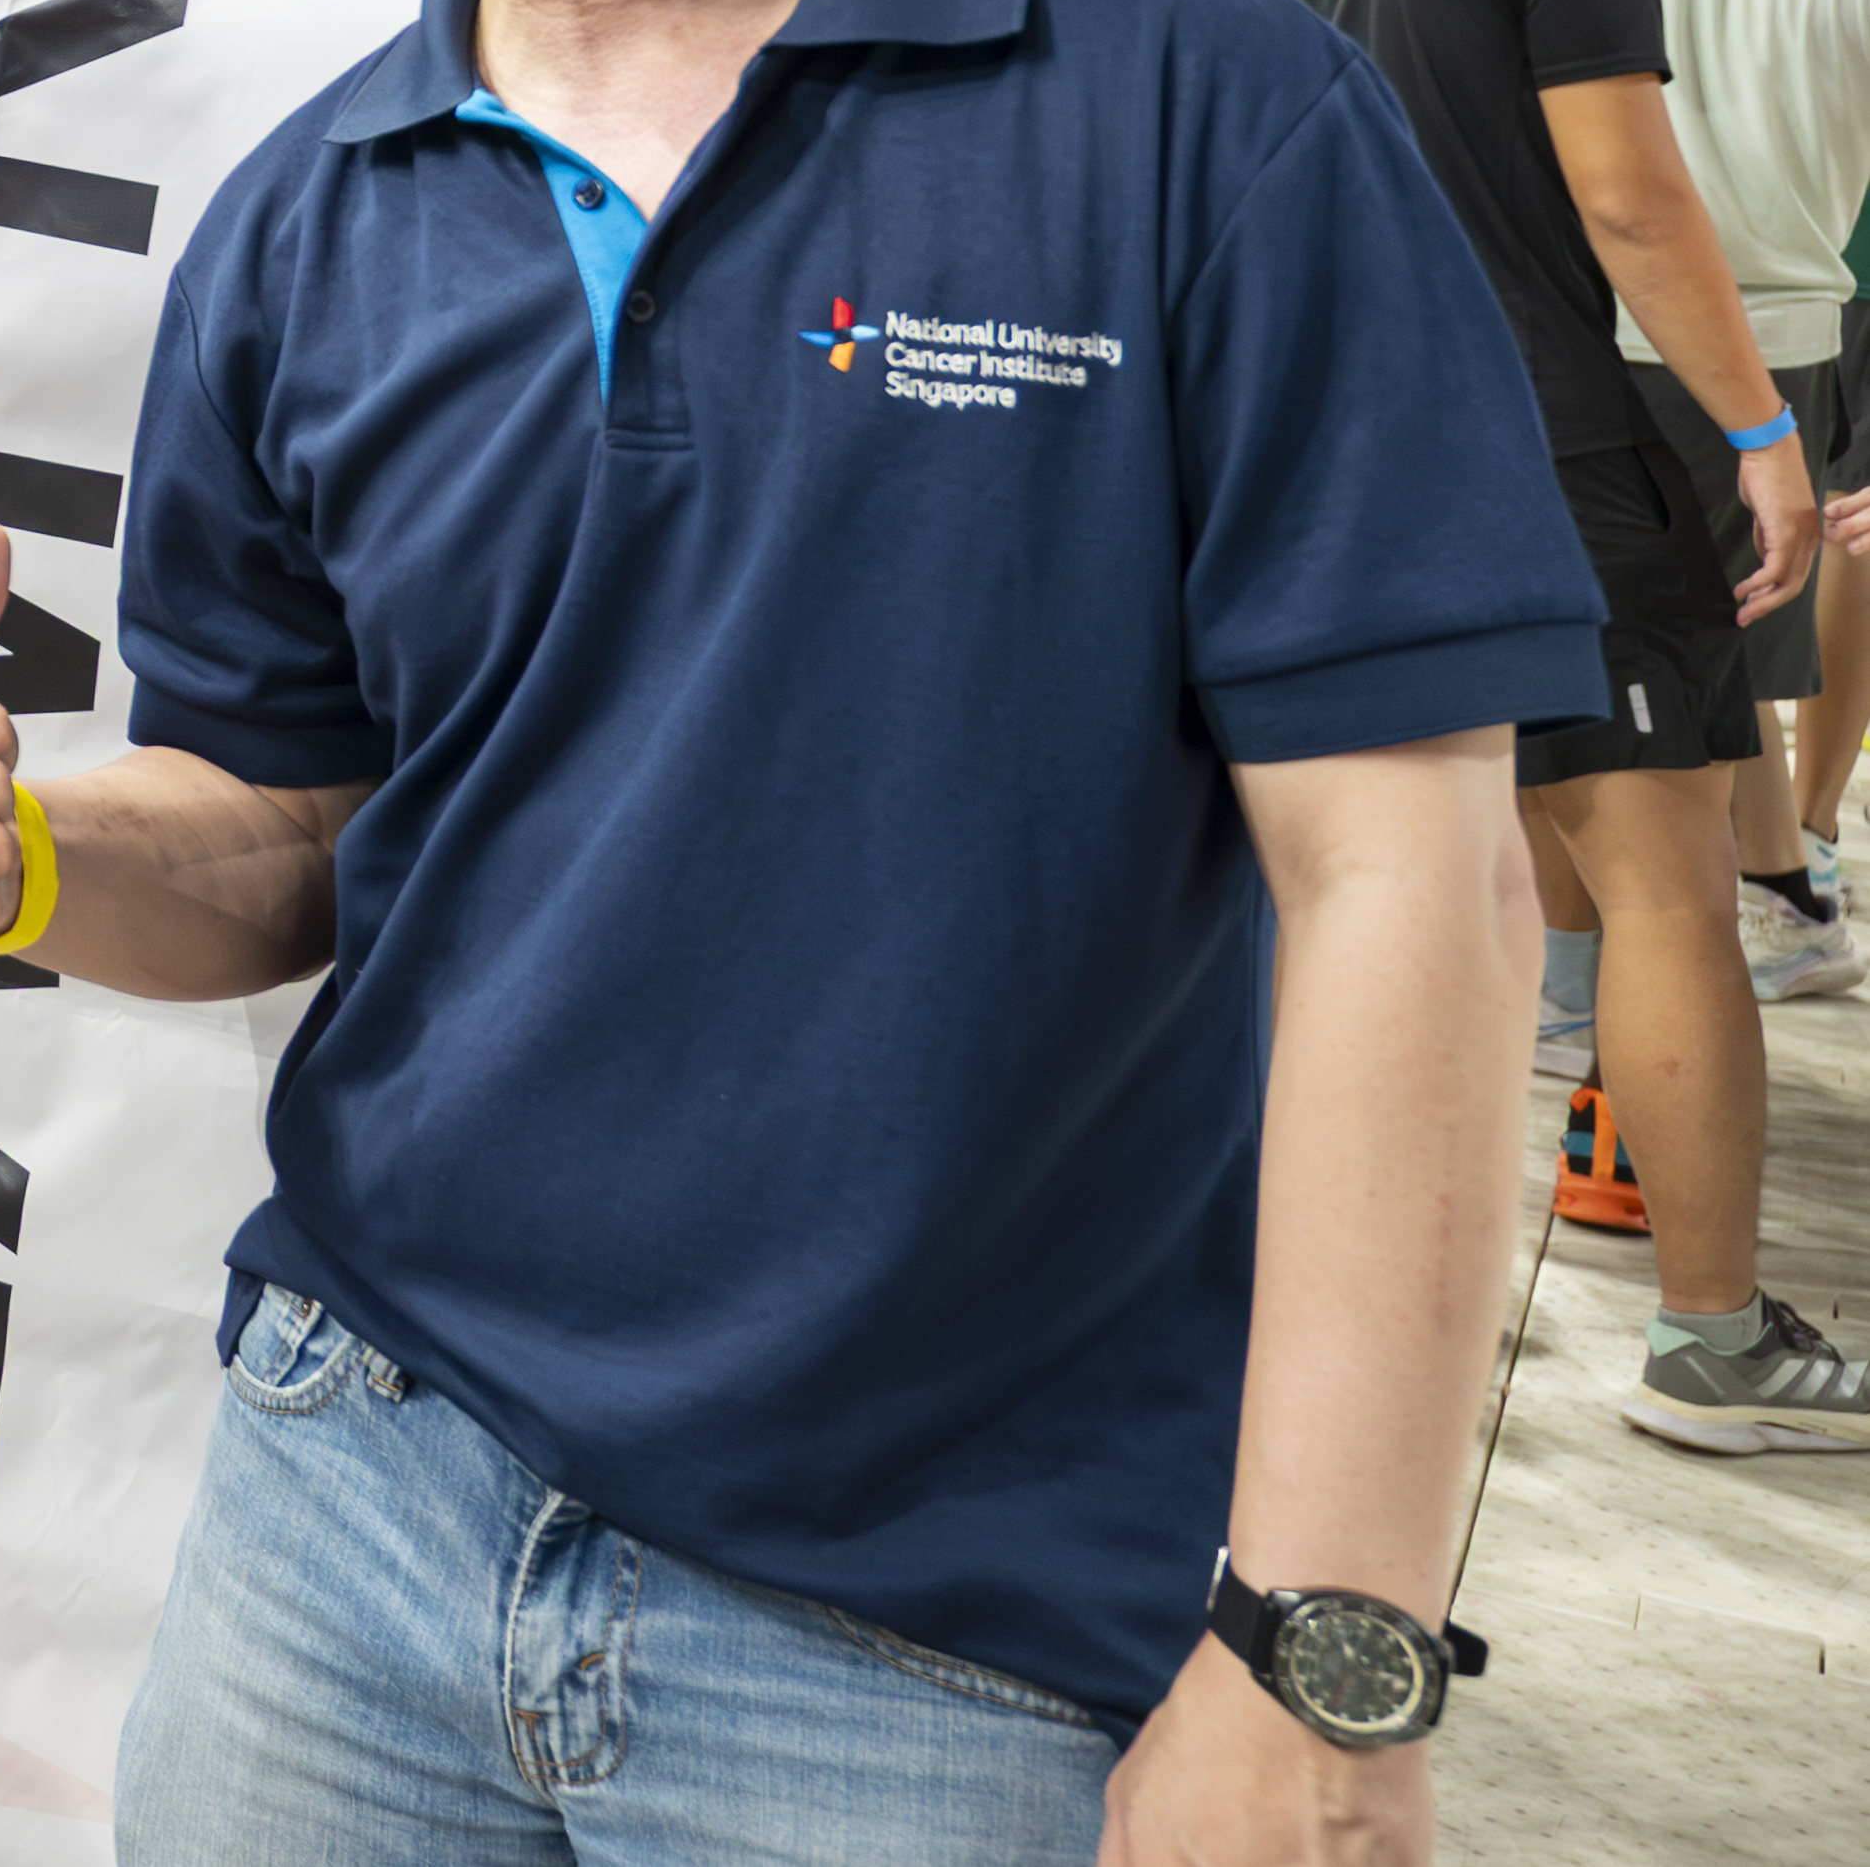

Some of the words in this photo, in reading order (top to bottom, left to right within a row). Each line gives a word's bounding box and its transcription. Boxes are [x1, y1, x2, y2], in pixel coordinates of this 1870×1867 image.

[885, 310, 995, 348] National
[997, 322, 1123, 366] University
[884, 341, 979, 375] Cancer
[979, 350, 1088, 388] Institute
[884, 370, 1017, 411] Singapore
